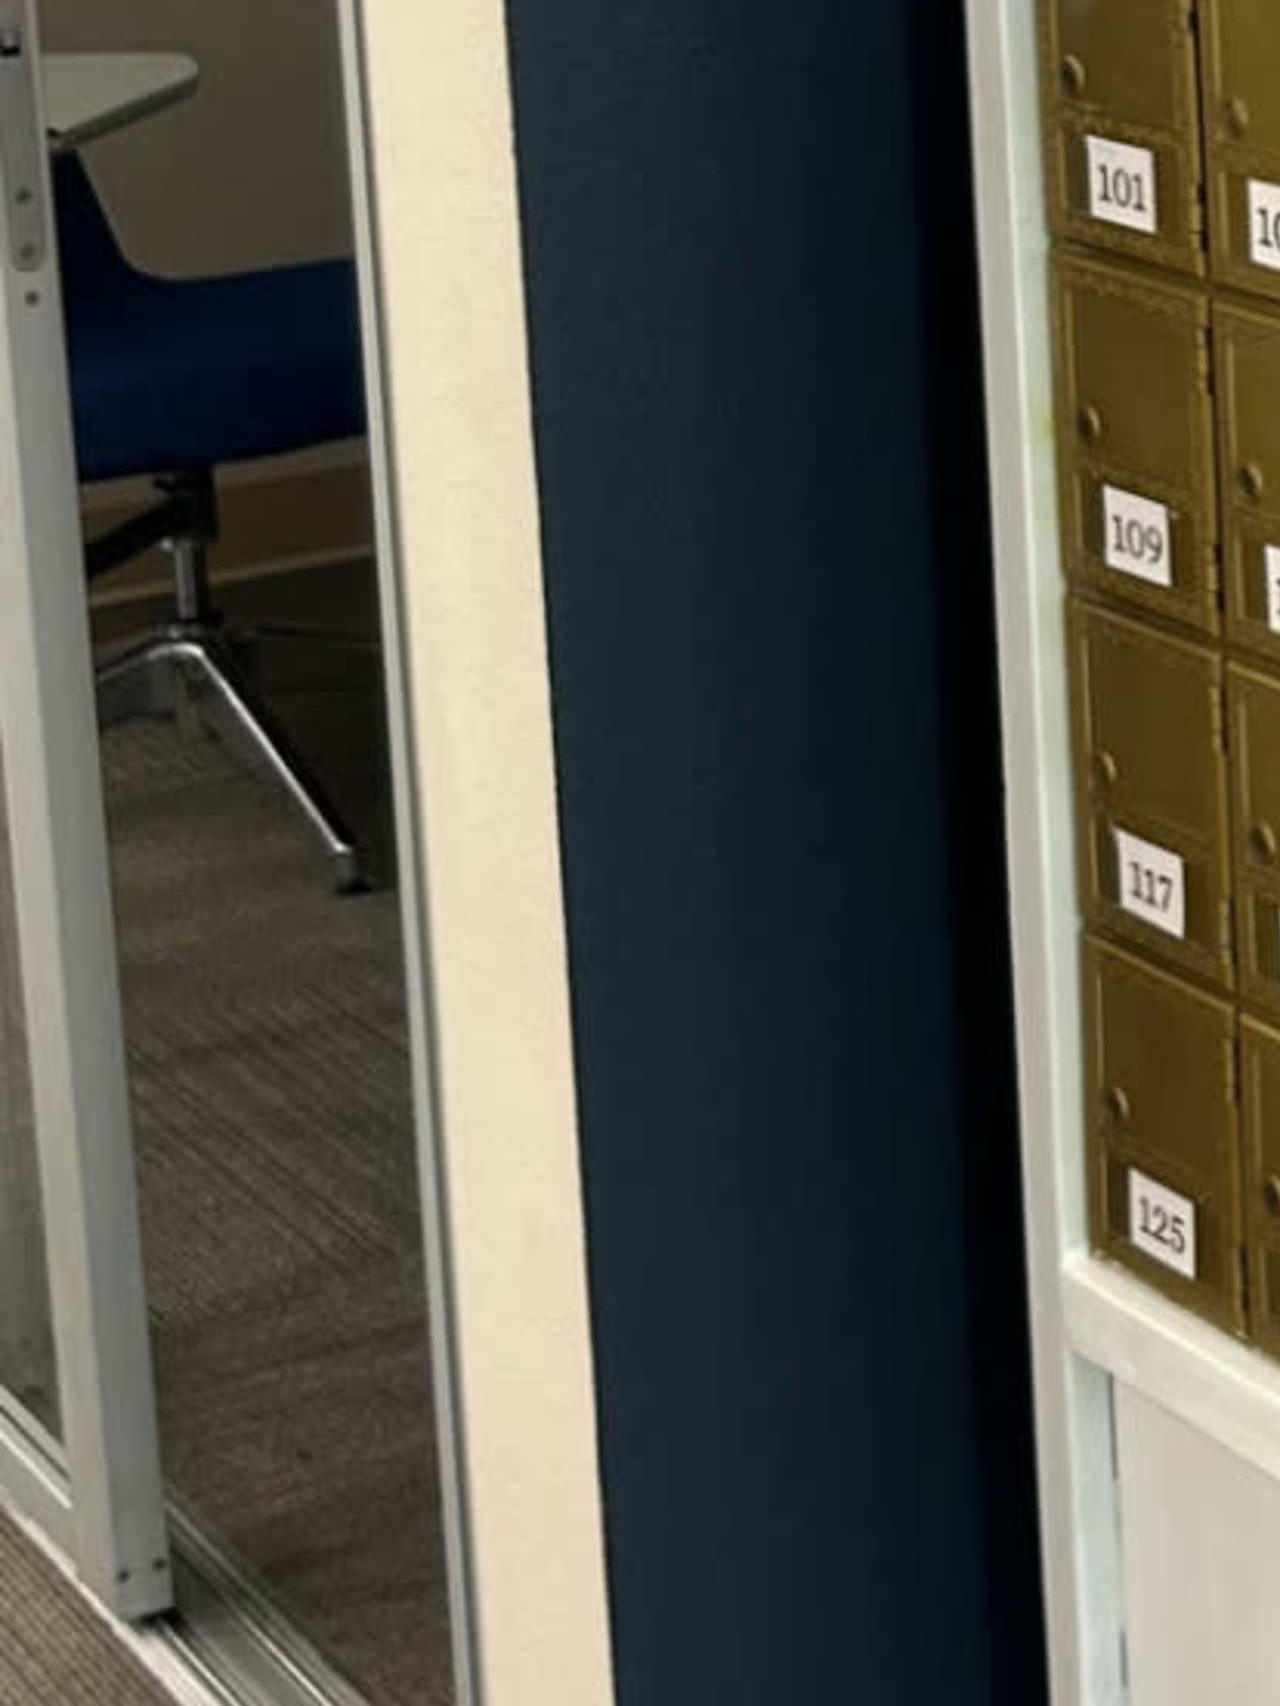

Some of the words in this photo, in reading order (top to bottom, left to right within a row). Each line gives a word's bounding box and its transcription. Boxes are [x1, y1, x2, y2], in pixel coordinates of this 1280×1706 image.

[1097, 163, 1147, 213] 101
[1111, 514, 1164, 565] 109
[1128, 861, 1173, 912] 117
[1138, 1196, 1186, 1255] 125
